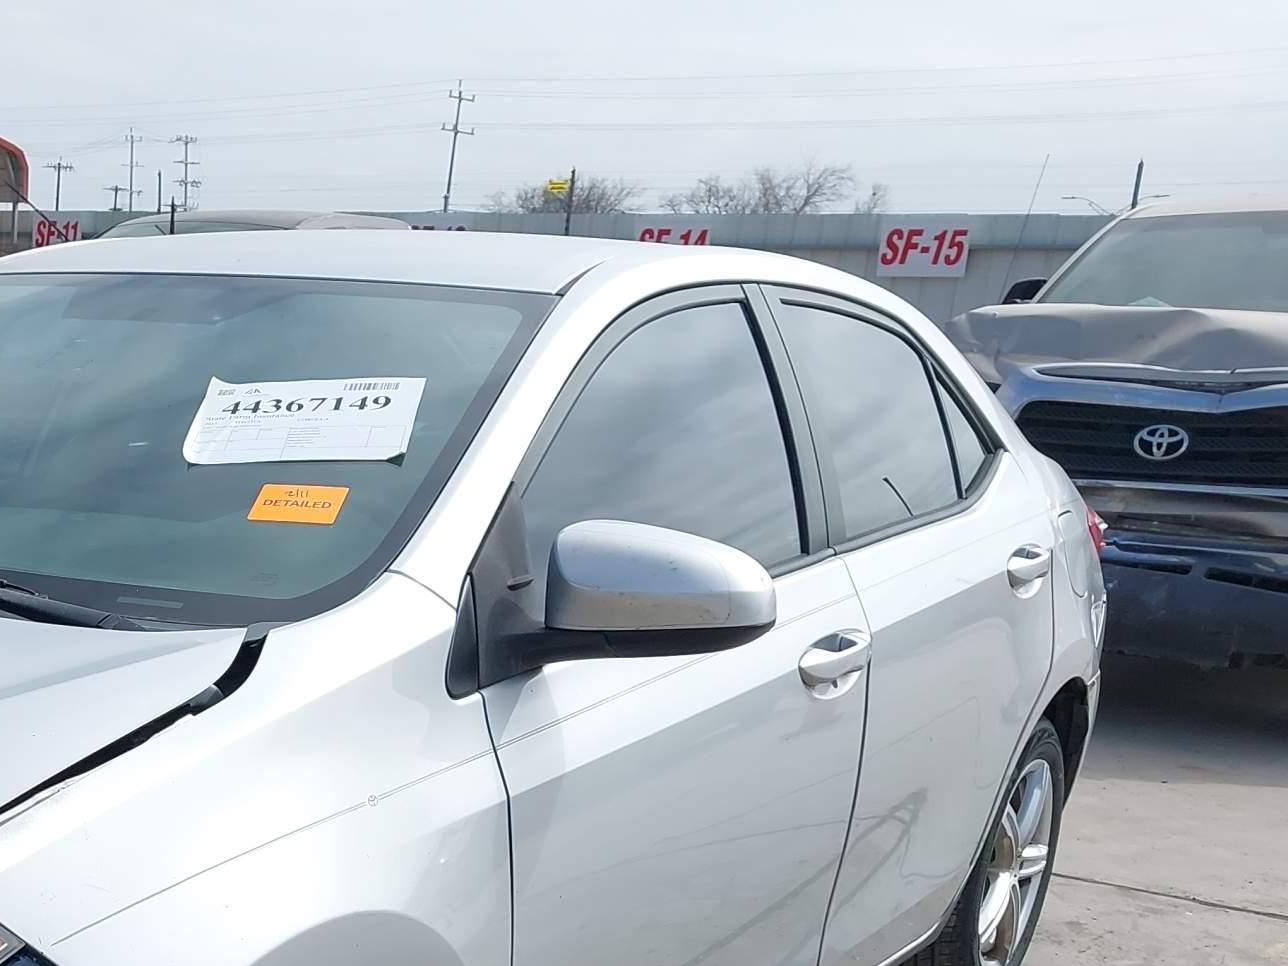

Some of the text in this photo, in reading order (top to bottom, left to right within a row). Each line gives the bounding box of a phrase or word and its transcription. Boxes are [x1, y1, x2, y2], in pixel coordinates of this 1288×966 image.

[35, 219, 79, 247] SF-11
[639, 228, 709, 246] SF14
[880, 228, 968, 266] SF-15
[221, 395, 392, 415] 44367149
[262, 499, 332, 509] DETAILED
